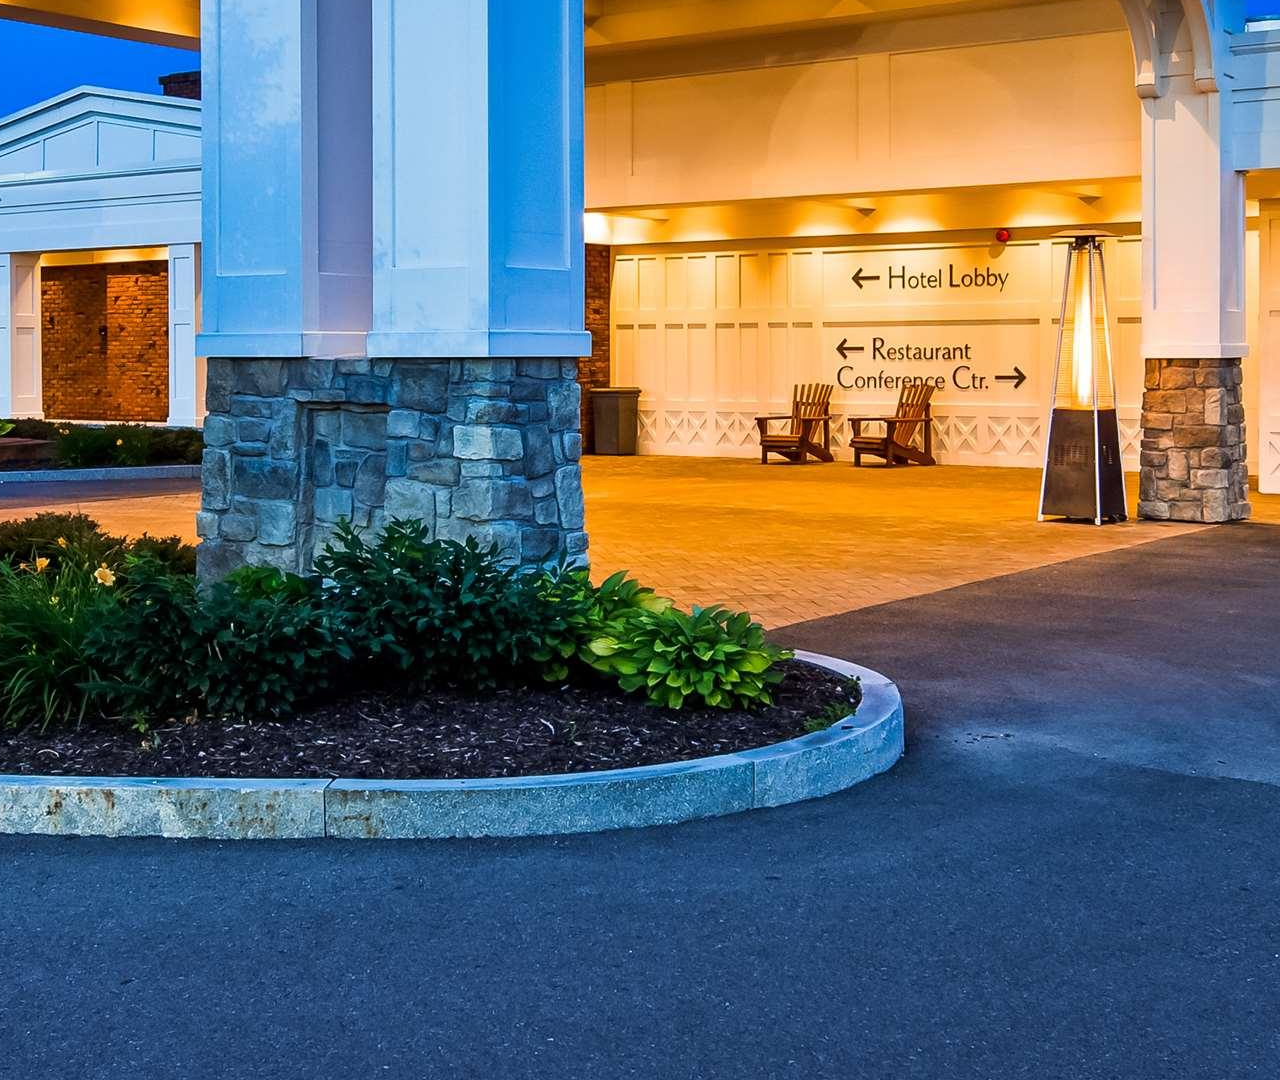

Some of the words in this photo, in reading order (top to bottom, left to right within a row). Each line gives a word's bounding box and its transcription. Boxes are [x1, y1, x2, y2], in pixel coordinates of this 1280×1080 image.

[888, 265, 942, 289] Hotel
[949, 264, 1009, 292] Lobby
[872, 337, 972, 360] Restaurant
[837, 366, 945, 389] Conference
[952, 366, 989, 389] Ctr.
